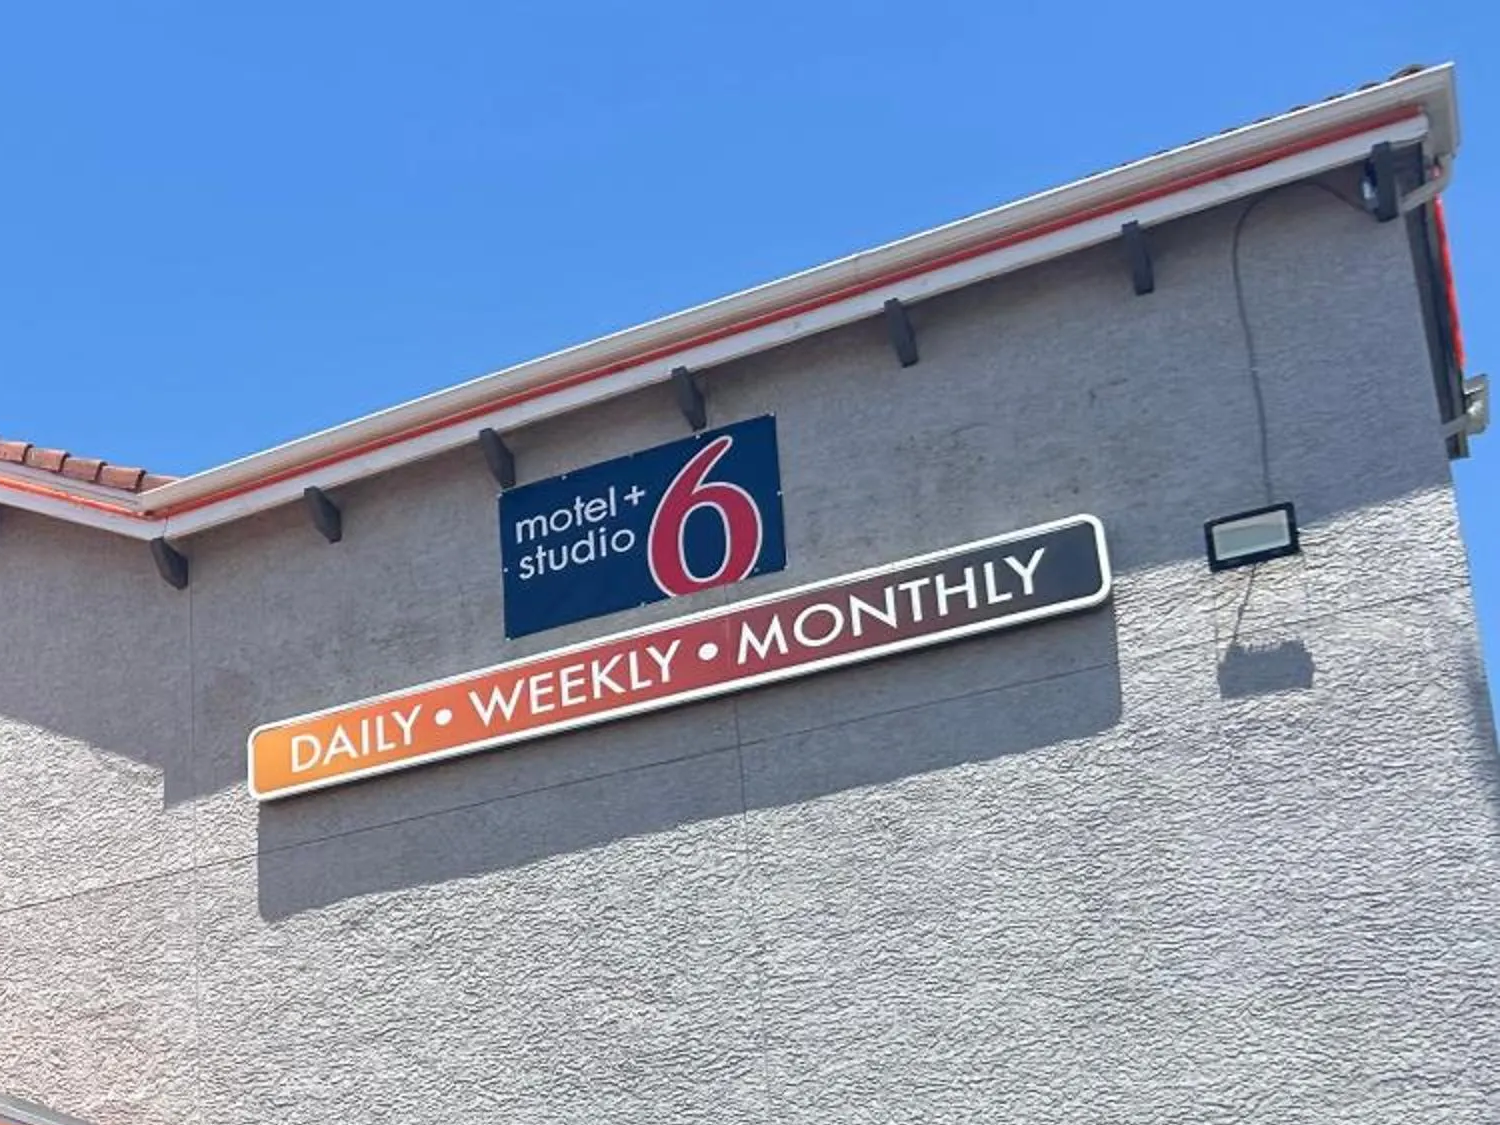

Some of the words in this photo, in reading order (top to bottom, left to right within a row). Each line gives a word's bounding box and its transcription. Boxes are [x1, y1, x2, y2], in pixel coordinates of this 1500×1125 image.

[515, 485, 617, 544] motel
[519, 527, 636, 580] studio
[647, 435, 763, 597] 6
[290, 705, 421, 774] DAILY
[469, 640, 681, 728] WEEKLY
[737, 548, 1045, 666] MONTHLY
